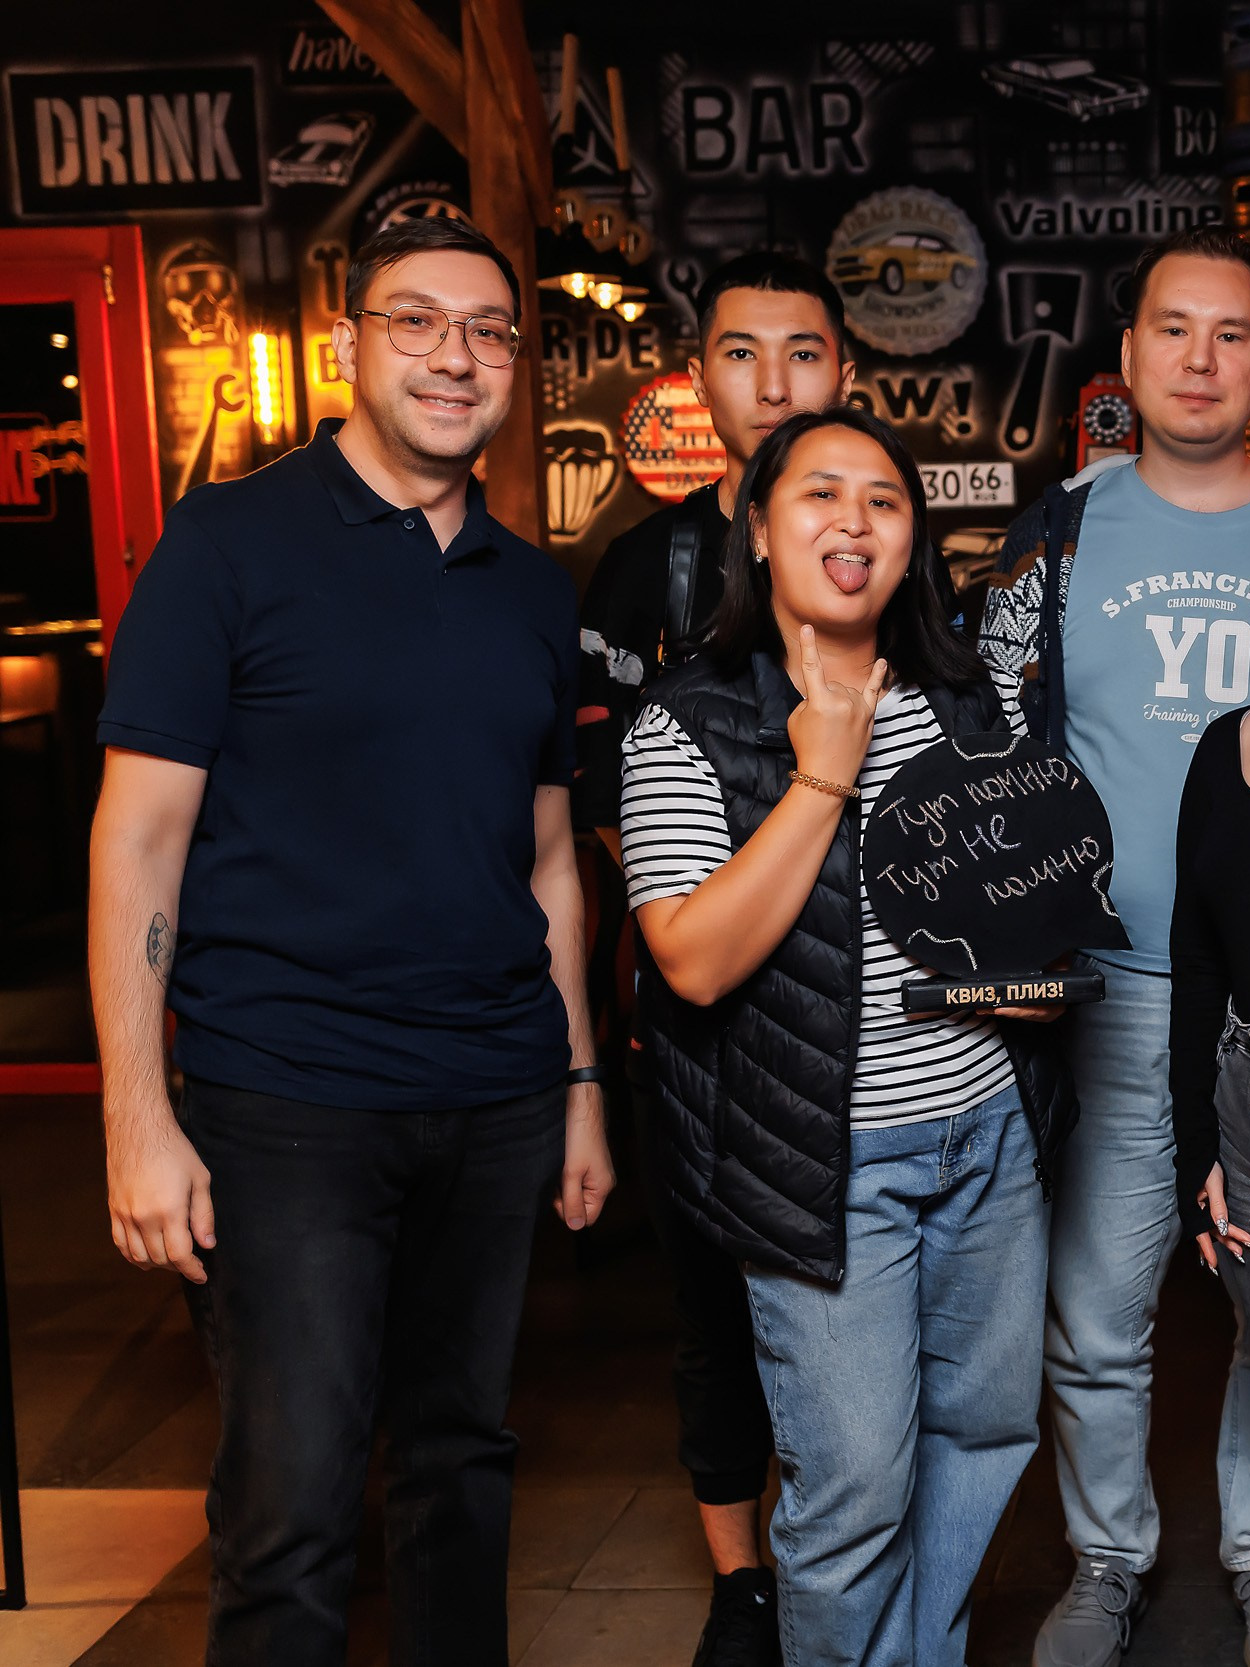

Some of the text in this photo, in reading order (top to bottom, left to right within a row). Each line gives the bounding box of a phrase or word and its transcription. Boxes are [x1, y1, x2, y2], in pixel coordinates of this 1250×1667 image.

[34, 92, 242, 188] DRINK
[683, 83, 865, 173] BAR
[1001, 199, 1223, 236] Valvoline
[970, 467, 1001, 490] 66
[1167, 597, 1237, 612] CHAMPIONSHIP
[1143, 703, 1200, 728] Training
[878, 793, 960, 847] Тут
[876, 855, 960, 901] Тут
[981, 835, 1101, 906] помню
[946, 981, 1064, 1005] КВИЗ, ПЛИЗ!
